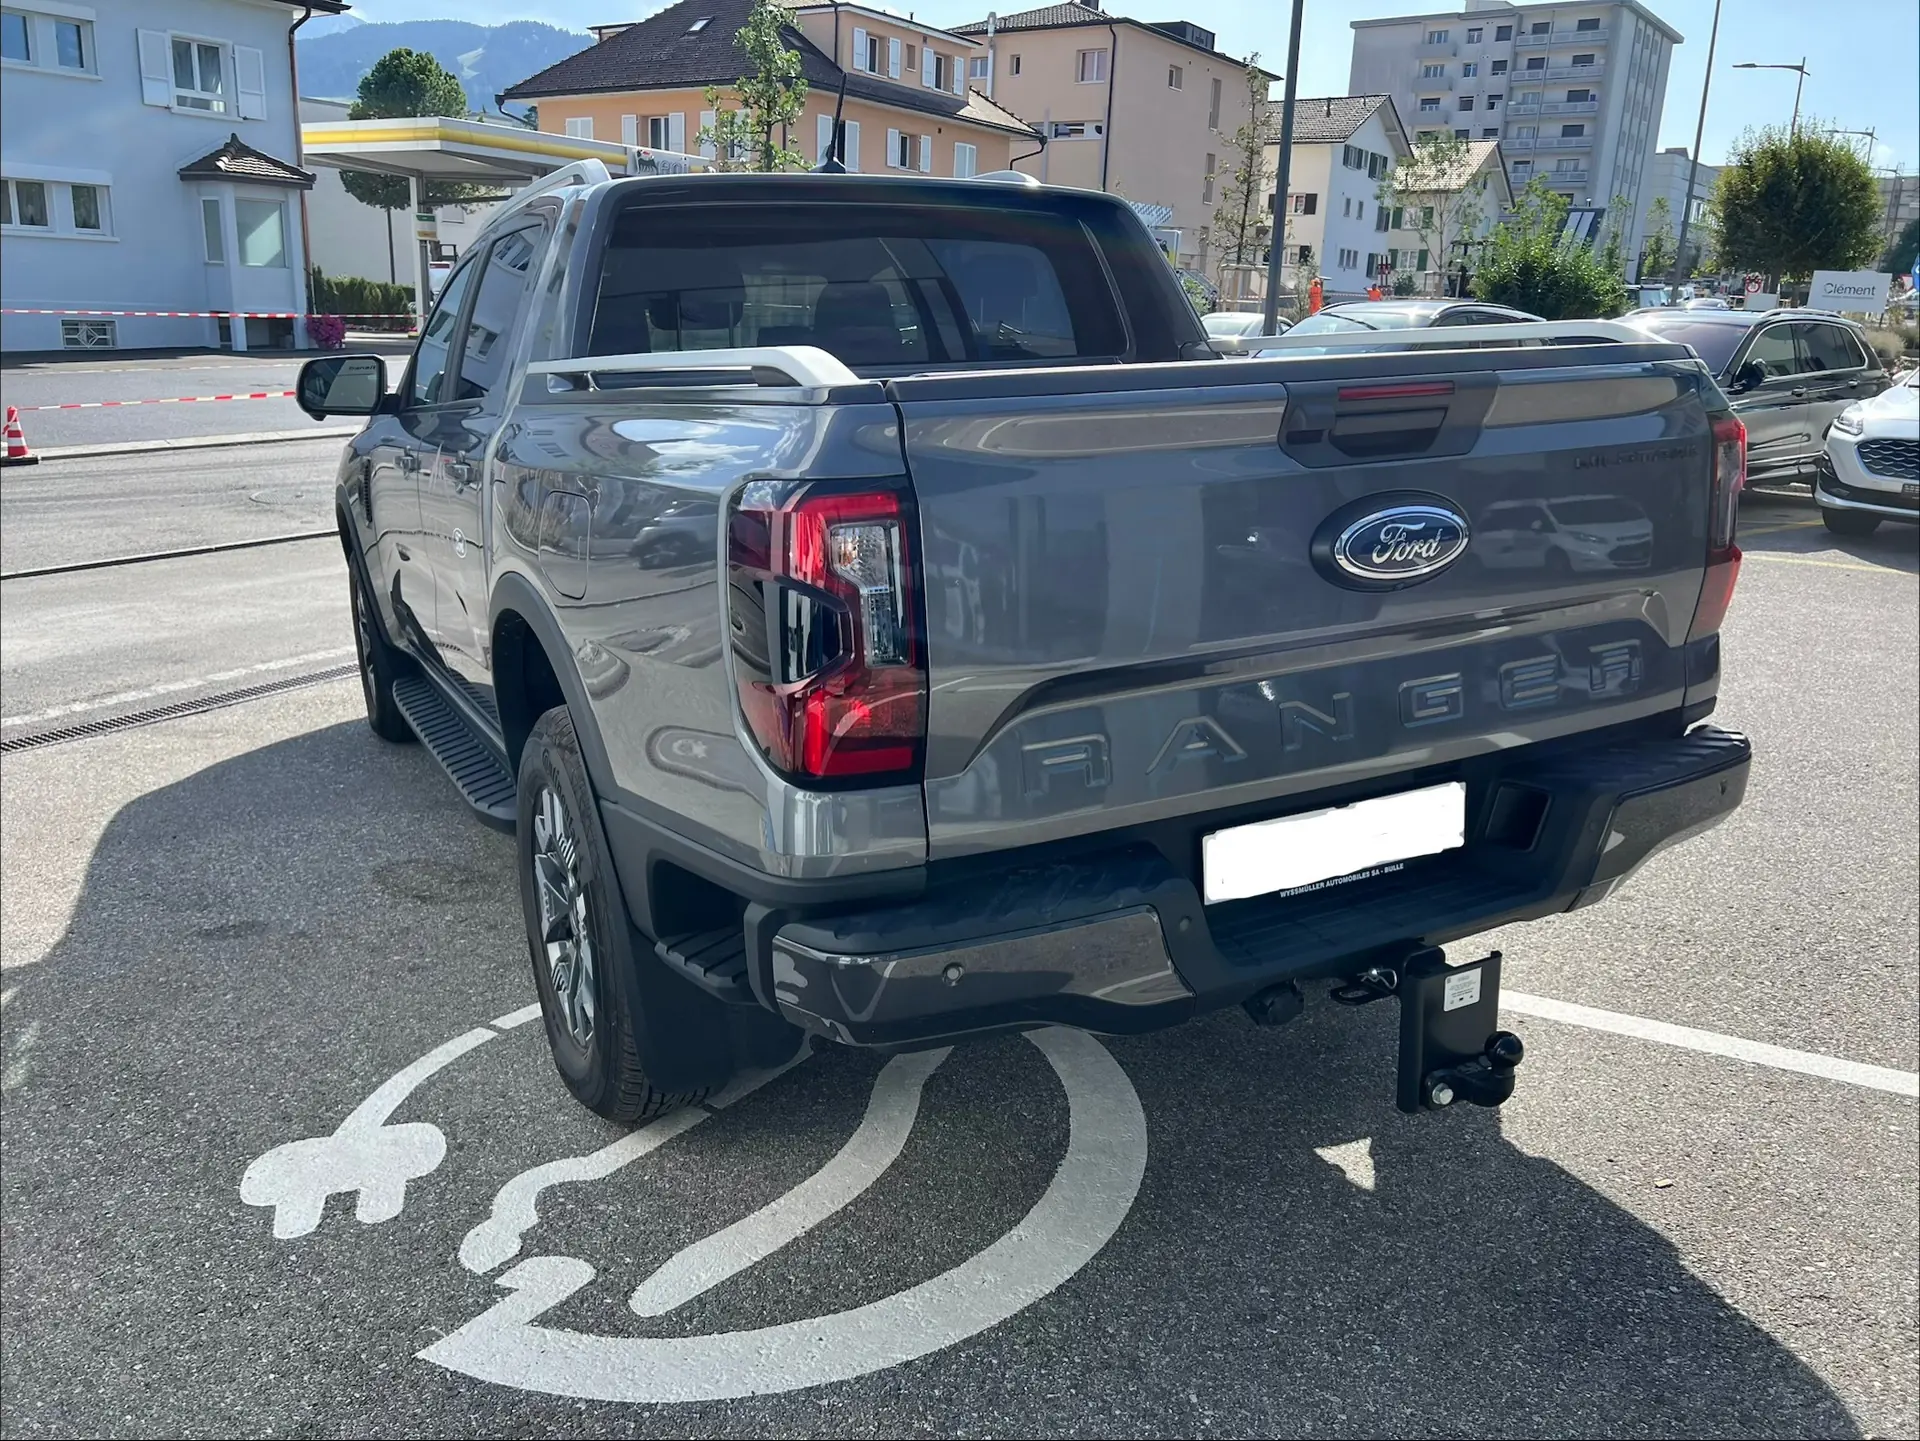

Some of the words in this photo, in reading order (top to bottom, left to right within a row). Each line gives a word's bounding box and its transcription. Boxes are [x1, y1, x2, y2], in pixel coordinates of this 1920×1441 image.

[1823, 282, 1876, 296] Clément
[1372, 521, 1443, 564] Ford
[1021, 638, 1644, 800] RANGER
[1280, 881, 1325, 898] WYSSMÜLLER
[1326, 872, 1370, 887] AUTOMOBILES
[1371, 868, 1380, 876] SA
[1384, 863, 1404, 873] BULLE
